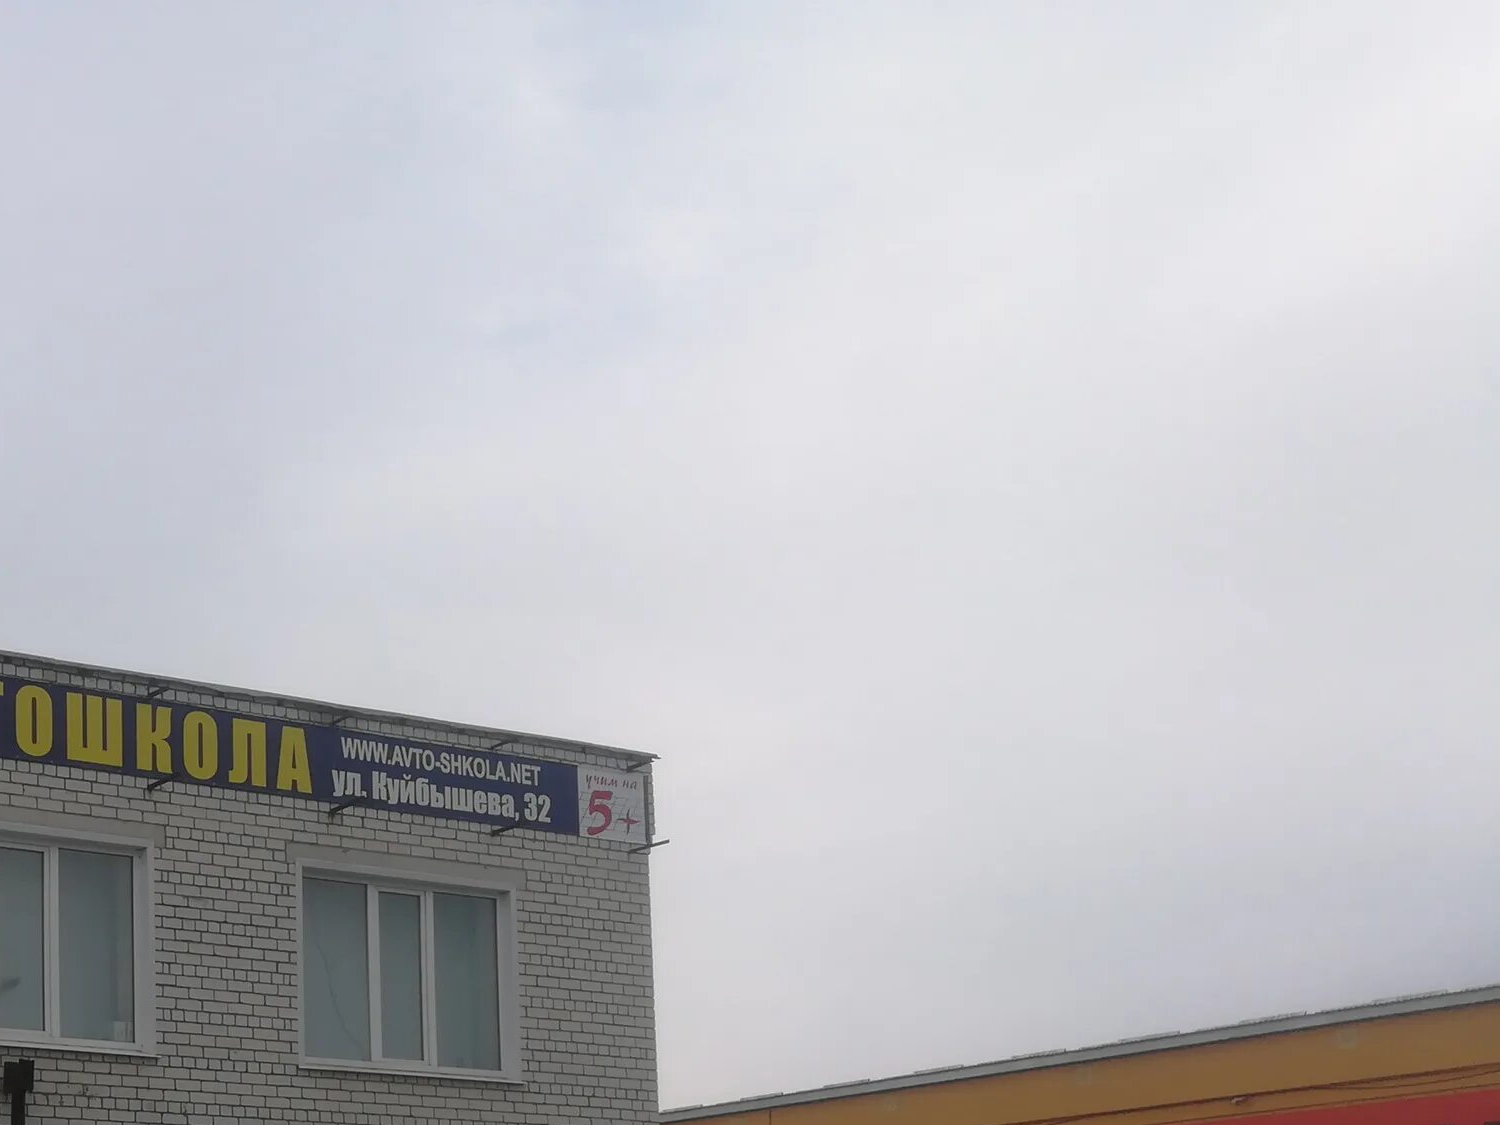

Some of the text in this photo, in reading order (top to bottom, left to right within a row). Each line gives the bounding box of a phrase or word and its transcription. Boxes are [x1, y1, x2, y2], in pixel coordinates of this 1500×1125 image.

[341, 736, 542, 787] WWW.AVTO-SHKOLA.NET
[332, 770, 552, 824] ул. Куйбышева, 32
